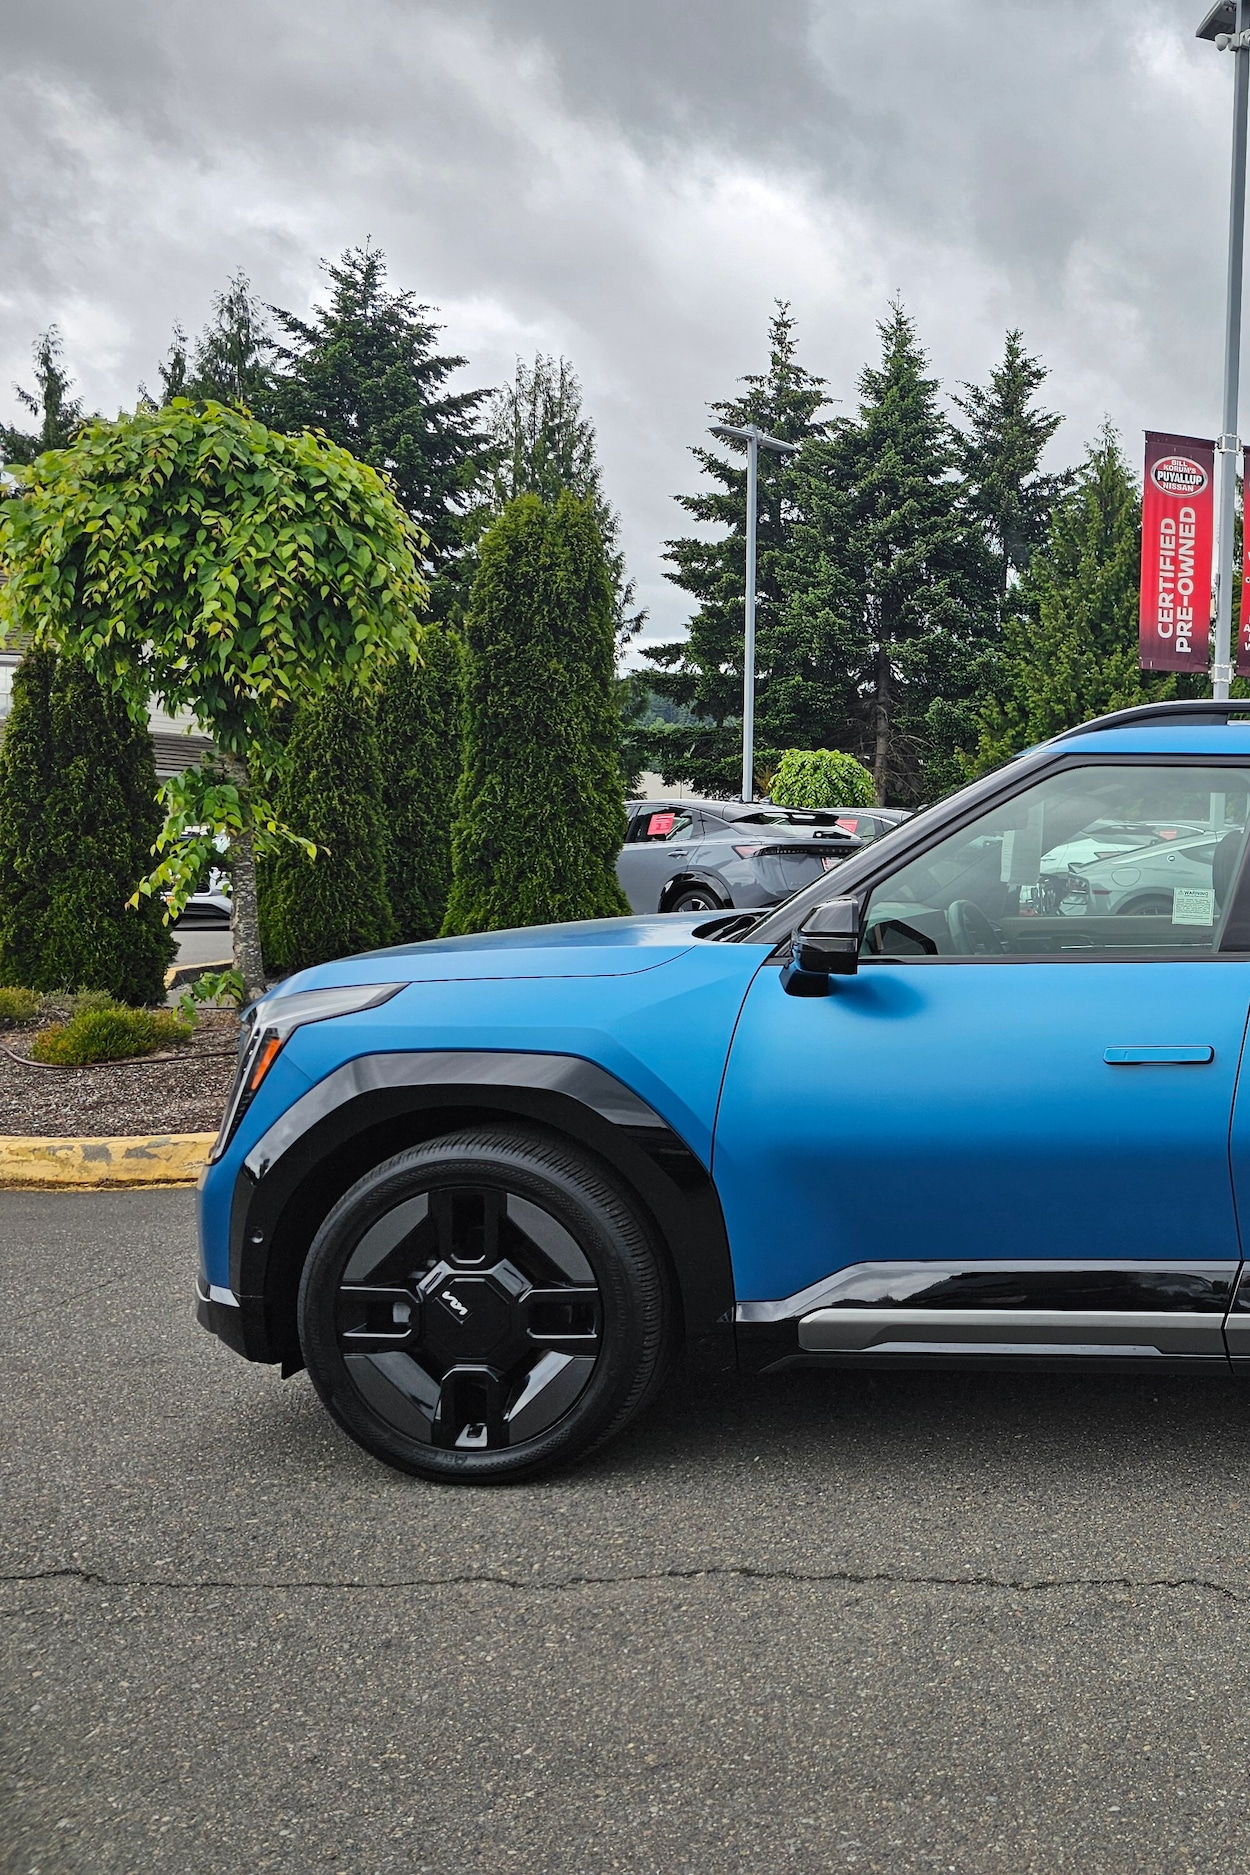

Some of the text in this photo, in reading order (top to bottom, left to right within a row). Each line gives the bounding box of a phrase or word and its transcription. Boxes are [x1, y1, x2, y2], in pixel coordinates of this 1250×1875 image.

[1163, 464, 1197, 474] KORUM'S
[1171, 459, 1188, 467] BILL
[1157, 470, 1203, 485] PUYALLUP
[1162, 482, 1194, 492] NISSAN
[1157, 517, 1176, 638] CERTIFIED
[1176, 506, 1196, 653] PRE-OWNED
